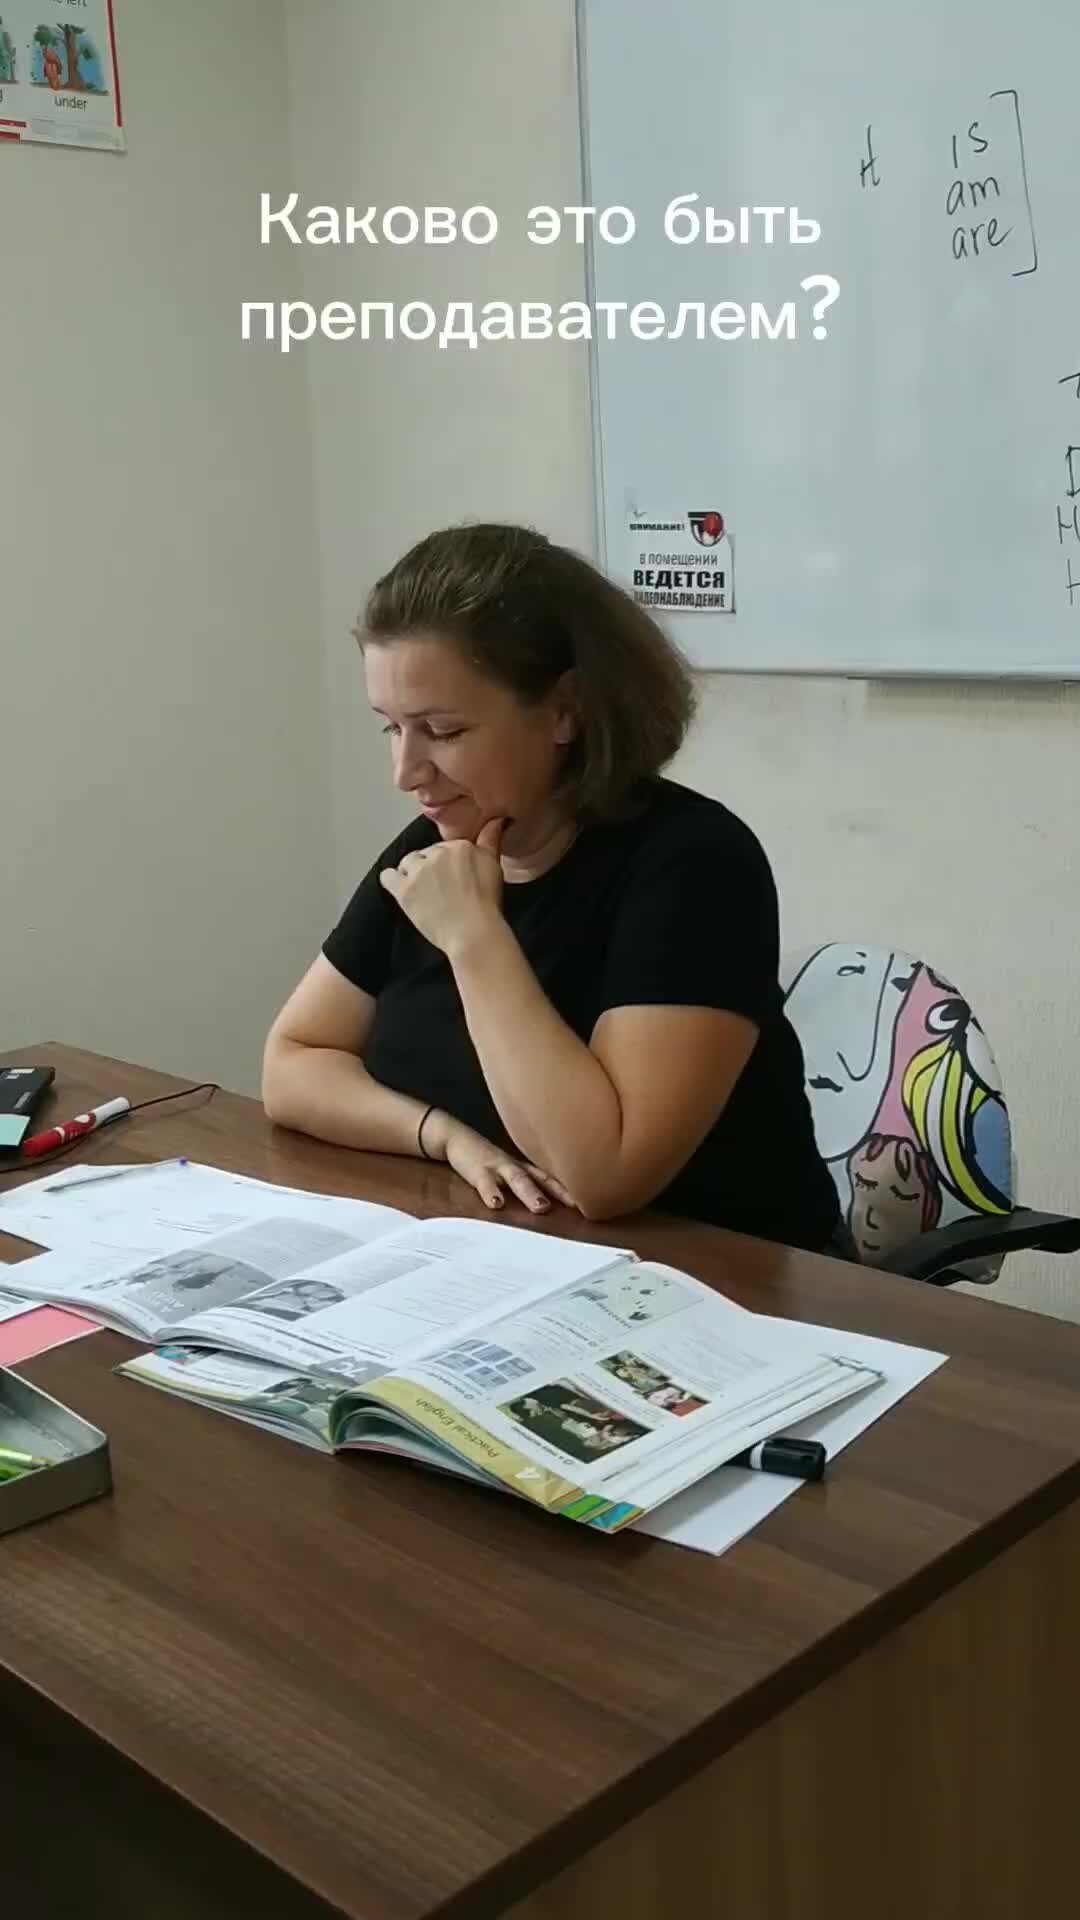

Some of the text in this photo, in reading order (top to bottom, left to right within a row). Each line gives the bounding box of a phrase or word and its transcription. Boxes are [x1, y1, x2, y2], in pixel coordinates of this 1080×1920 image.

[54, 96, 87, 111] under
[947, 177, 1000, 215] am
[953, 218, 1015, 259] are
[648, 553, 718, 566] помещении
[633, 570, 725, 589] ВЕДЕТСЯ
[416, 1398, 456, 1430] English
[455, 1421, 499, 1459] Practical
